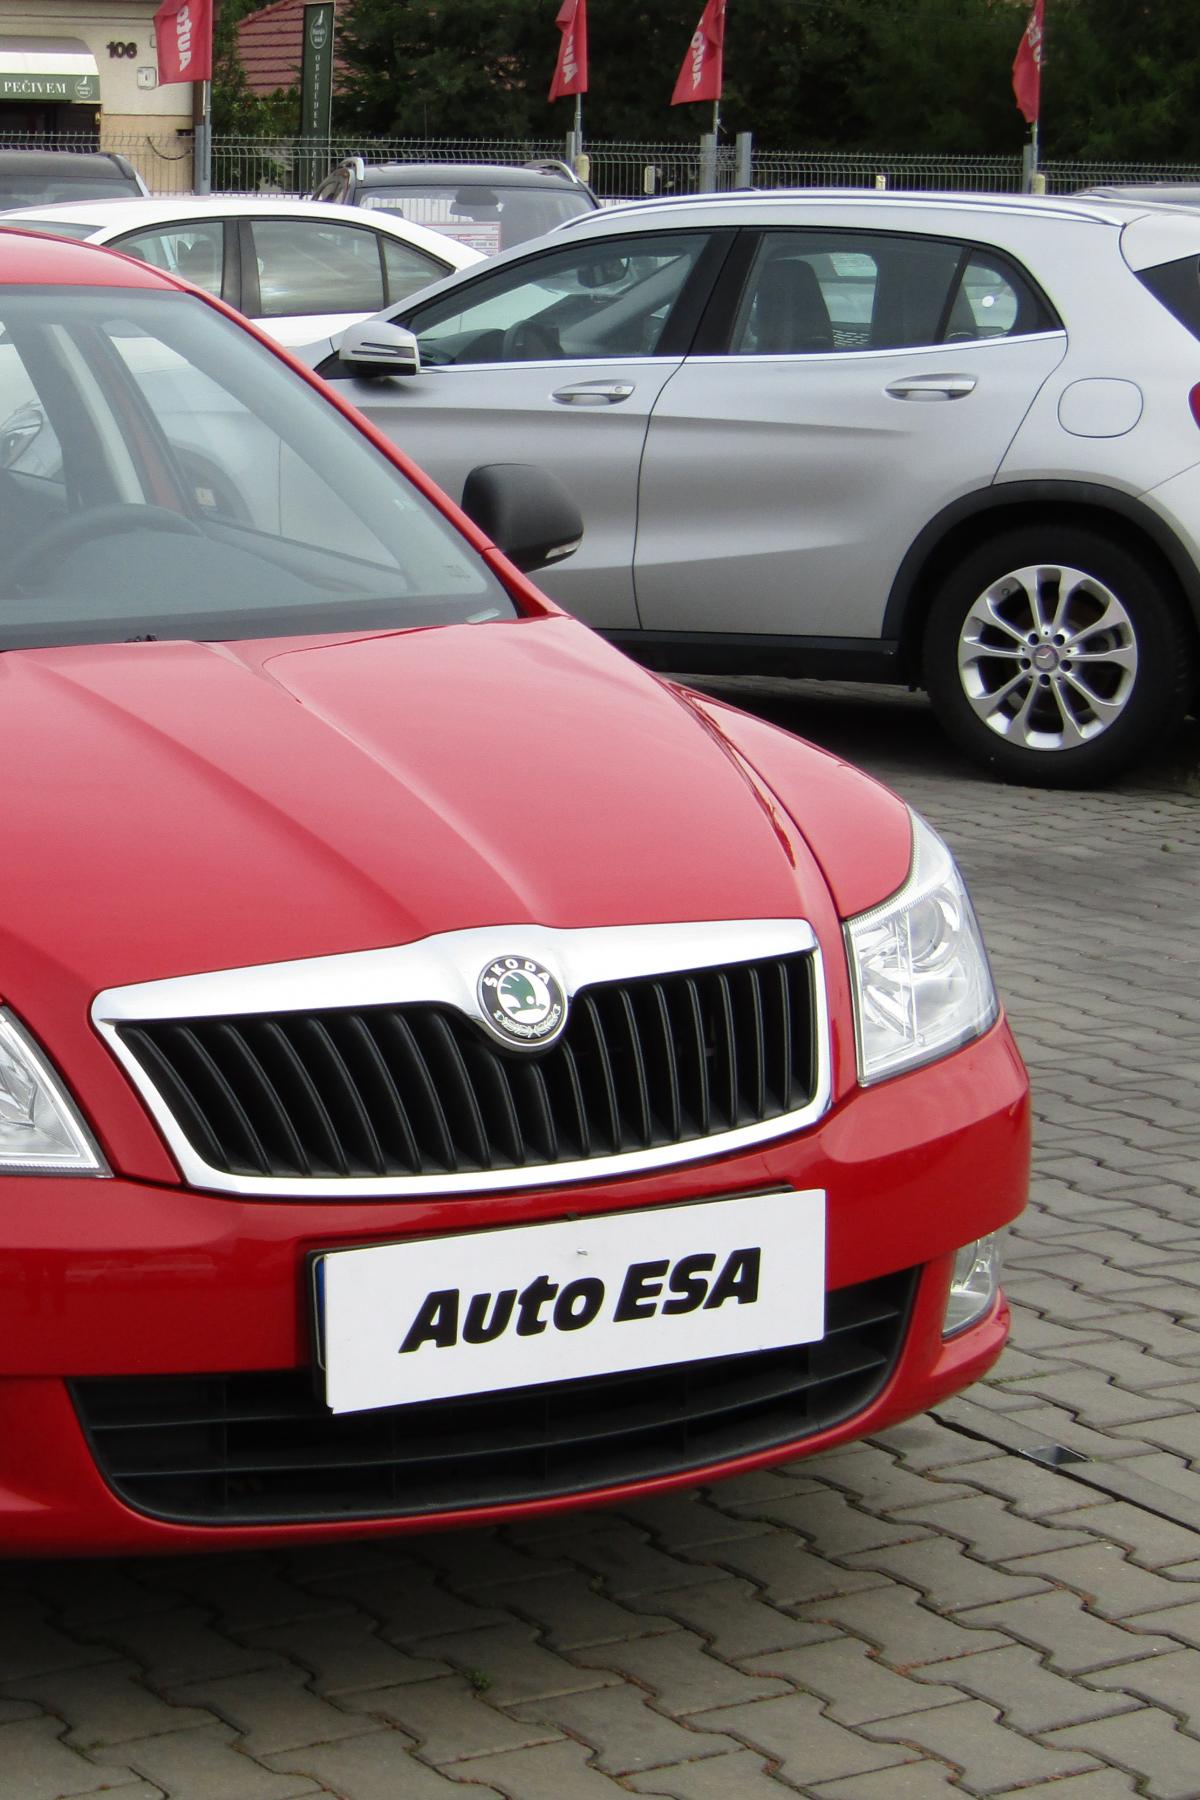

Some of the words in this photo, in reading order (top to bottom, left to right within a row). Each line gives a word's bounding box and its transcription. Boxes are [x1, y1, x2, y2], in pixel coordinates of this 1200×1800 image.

[105, 40, 138, 59] 106
[4, 80, 67, 95] PEČIVEM
[397, 1274, 606, 1354] Auto
[612, 1246, 762, 1324] ESA
